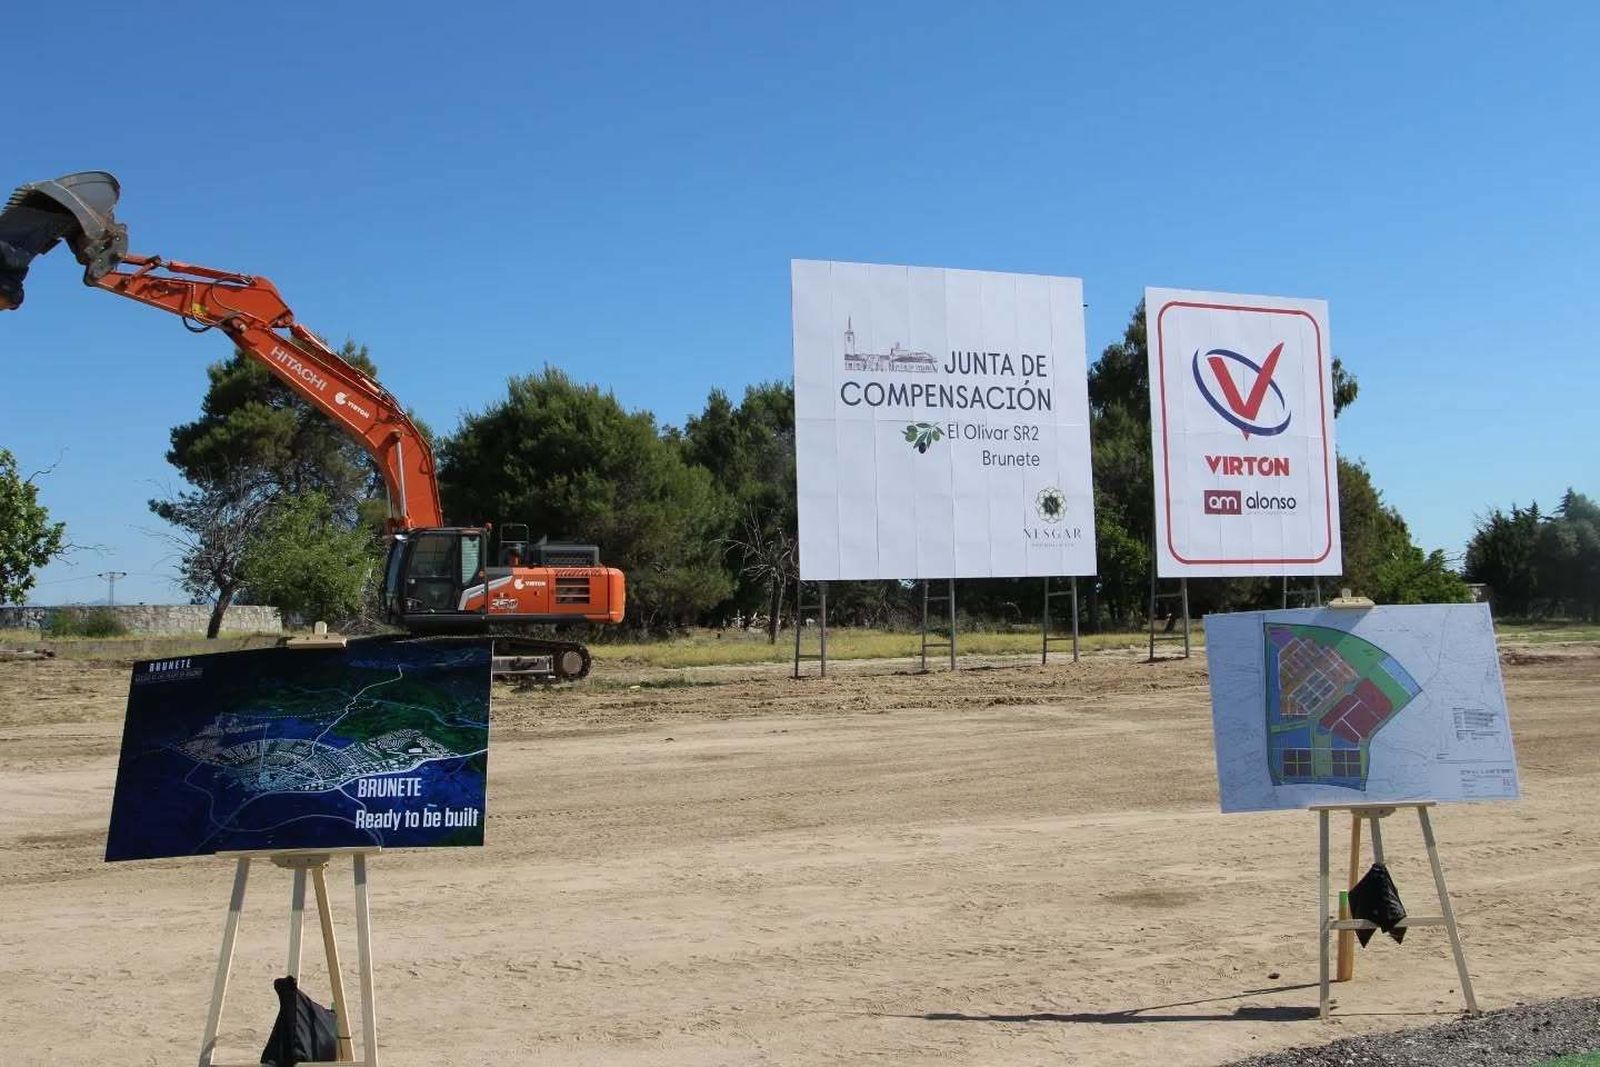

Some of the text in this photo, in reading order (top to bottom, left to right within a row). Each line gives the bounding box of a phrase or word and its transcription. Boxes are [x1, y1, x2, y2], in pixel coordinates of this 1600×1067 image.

[270, 346, 328, 391] HITACHI
[945, 351, 1047, 377] JUNTA DE
[841, 379, 1052, 411] COMPENSACIÓN
[948, 424, 1039, 441] El Olivar SR2
[982, 450, 1040, 466] Brunete
[1205, 455, 1290, 477] VIRTON
[1208, 491, 1296, 509] am alonso
[357, 777, 422, 798] BRUNETE
[355, 807, 479, 831] Ready to be built
